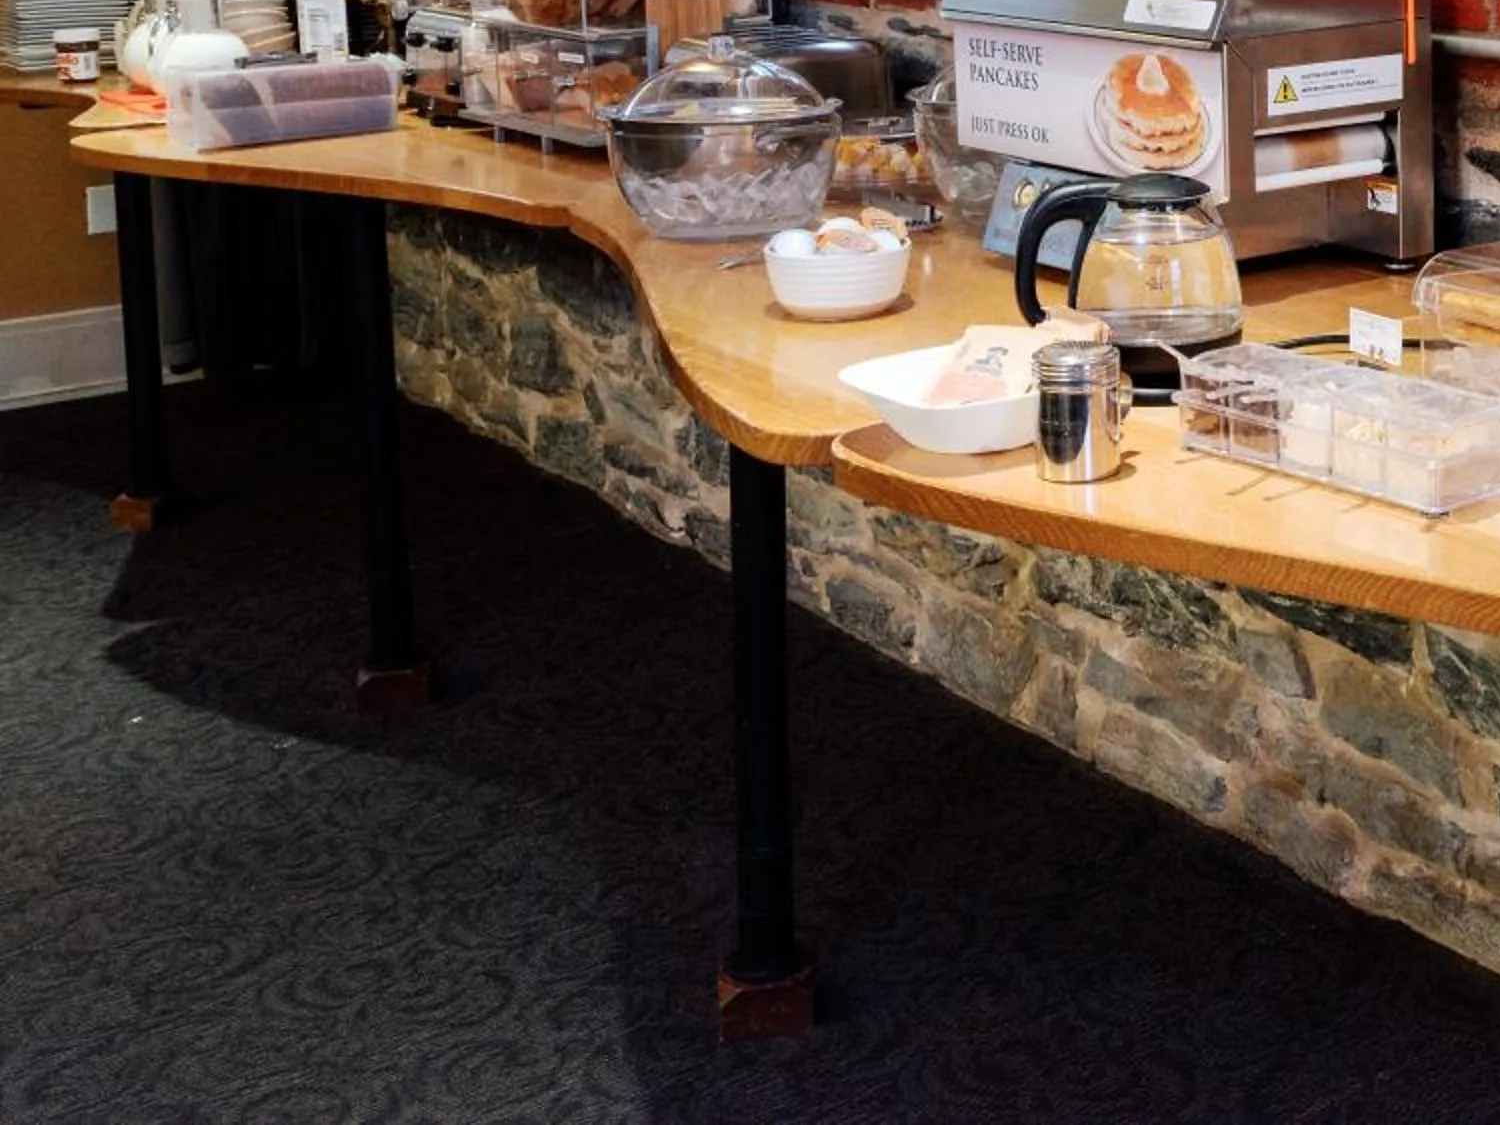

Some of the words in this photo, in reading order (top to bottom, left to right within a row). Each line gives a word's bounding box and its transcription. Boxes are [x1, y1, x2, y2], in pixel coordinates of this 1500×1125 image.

[968, 37, 1044, 67] SELF-SERVE
[969, 63, 1039, 92] PANCAKES
[971, 115, 995, 134] JUST
[997, 121, 1029, 140] PRESS
[1031, 127, 1049, 144] OK
